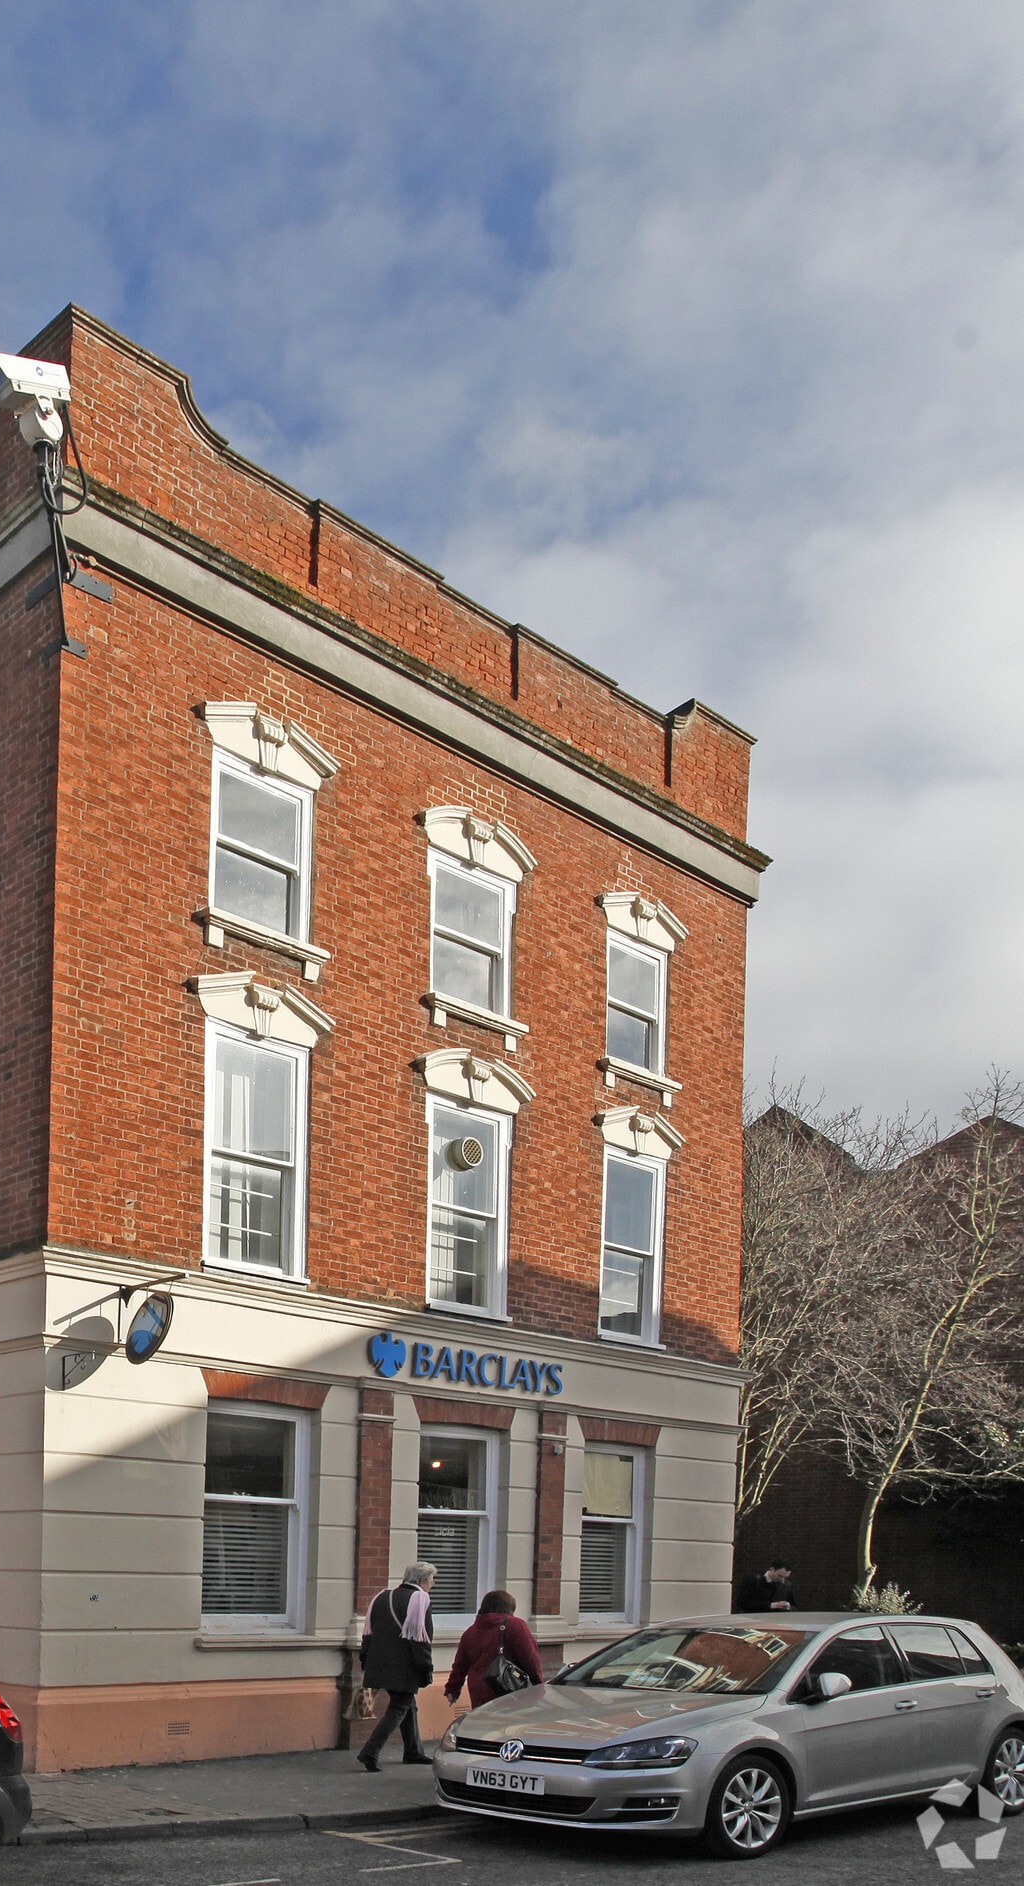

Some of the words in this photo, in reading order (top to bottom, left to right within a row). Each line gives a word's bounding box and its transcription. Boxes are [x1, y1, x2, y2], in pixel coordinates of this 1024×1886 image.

[413, 1342, 564, 1396] BARCLAYS
[473, 1770, 506, 1787] VN63
[509, 1775, 539, 1792] GYT
